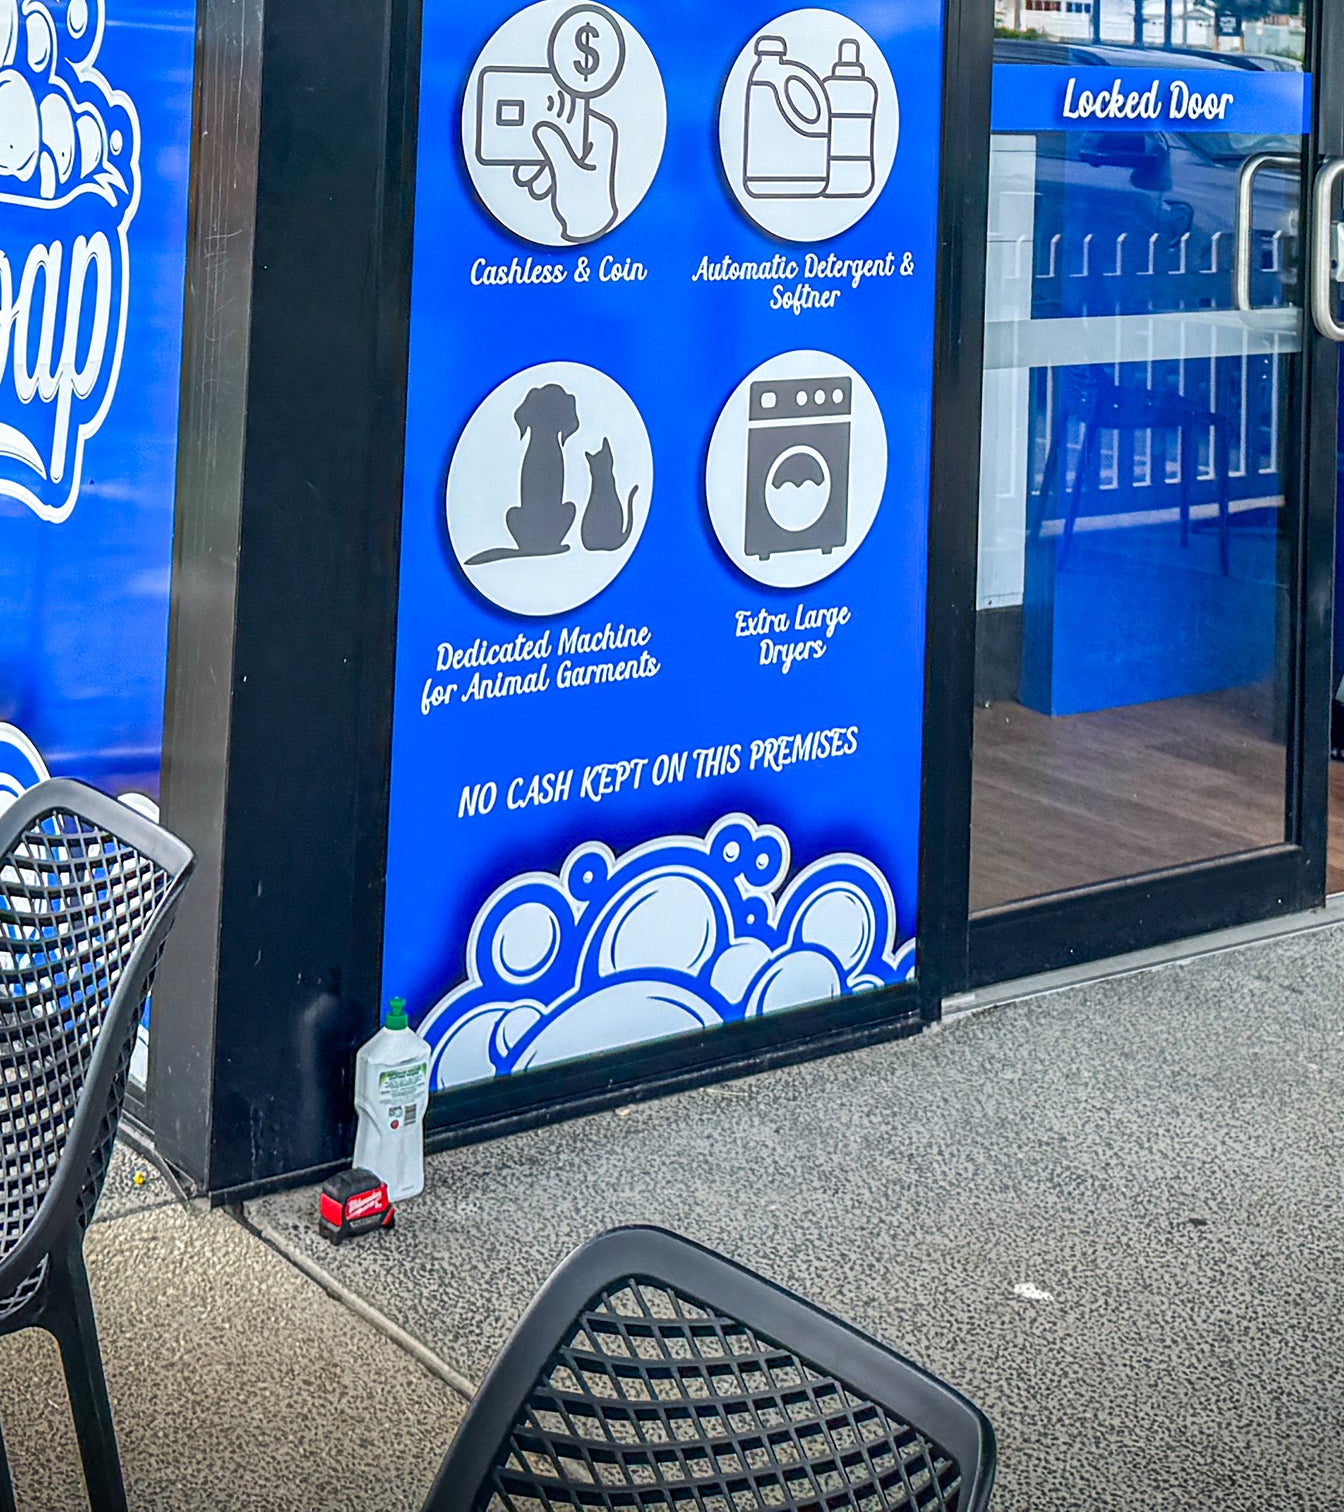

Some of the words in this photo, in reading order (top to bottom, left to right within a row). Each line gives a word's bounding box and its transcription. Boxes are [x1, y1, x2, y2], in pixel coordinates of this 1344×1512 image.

[1062, 77, 1161, 120] Locked
[1168, 80, 1234, 121] Door
[470, 257, 566, 286] Cashless
[575, 256, 590, 282] &
[599, 255, 647, 282] Coin
[692, 255, 798, 281] Automatic
[805, 253, 894, 288] Detergent
[902, 252, 915, 276] &
[770, 285, 840, 315] Softner
[735, 609, 789, 637] Extra
[794, 602, 850, 638] Large
[436, 630, 552, 673] Dedicated
[557, 623, 651, 656] Machine
[759, 640, 826, 674] Dryers
[421, 682, 458, 715] for
[461, 664, 549, 703] Animal
[556, 651, 660, 688] Garments
[458, 785, 496, 819] NO
[506, 773, 570, 810] CASH
[580, 758, 646, 801] KEPT
[652, 751, 688, 786] ON
[692, 744, 740, 778] THIS
[749, 725, 858, 772] PREMISES
